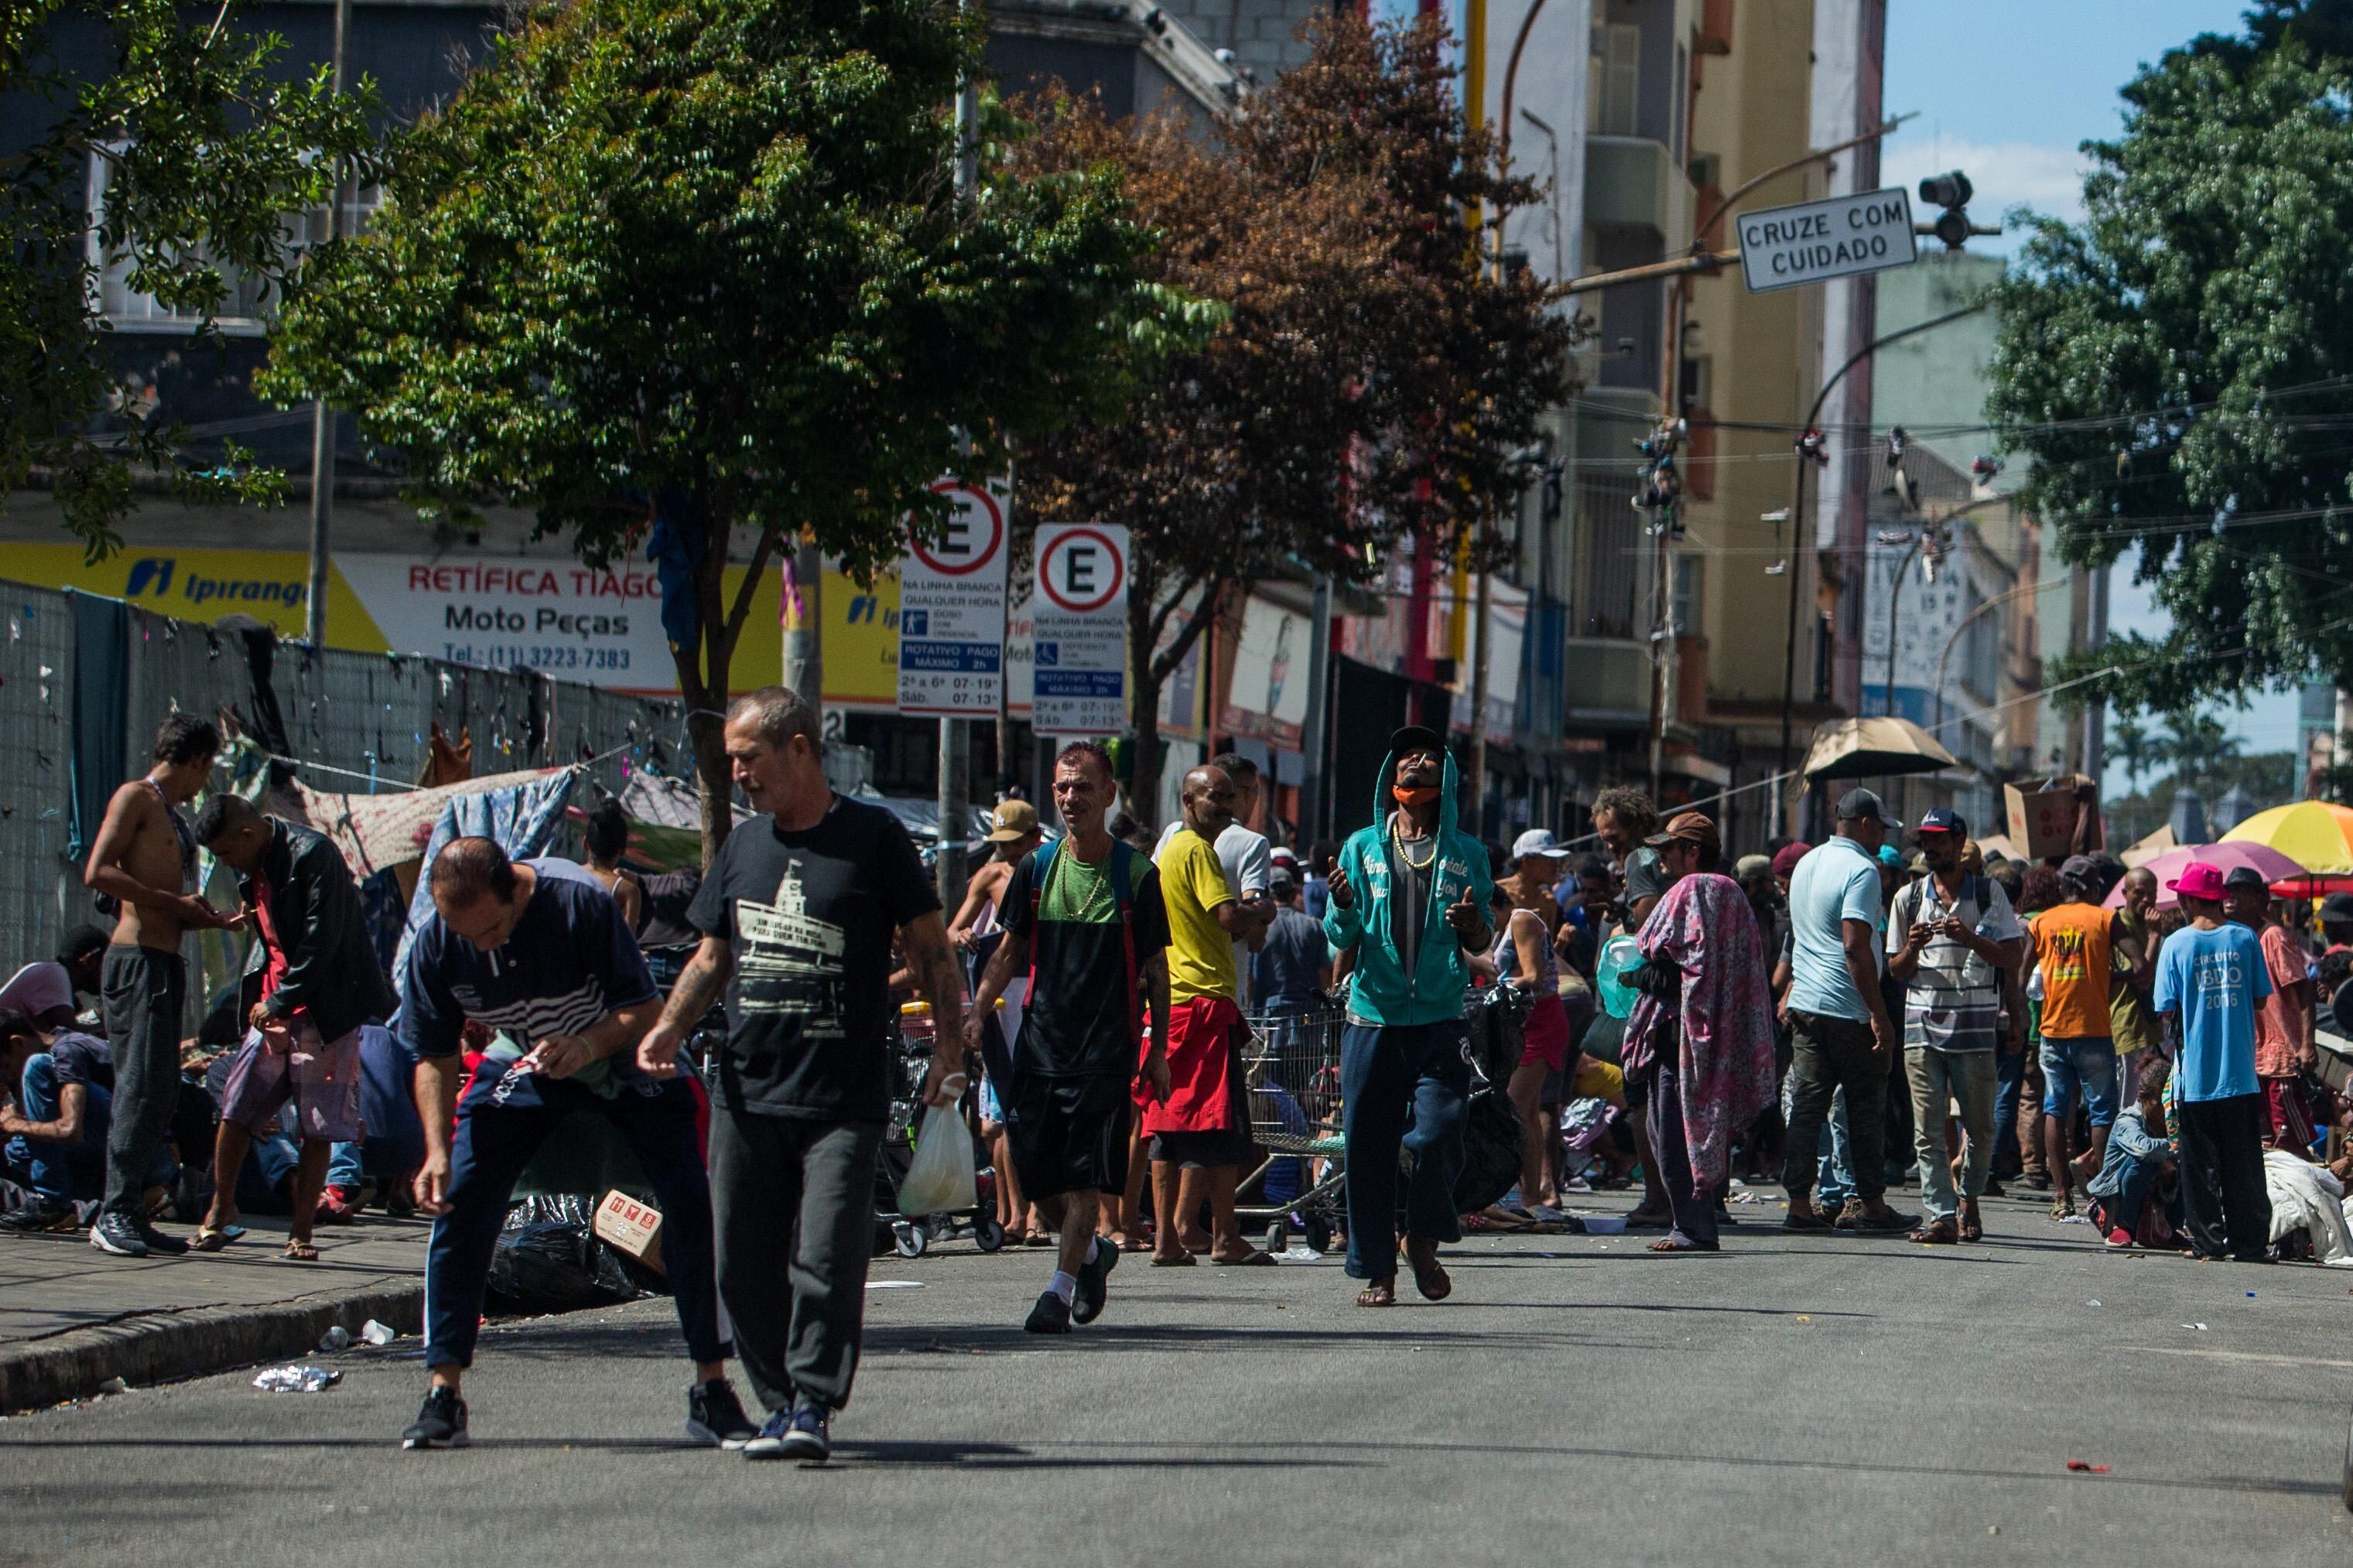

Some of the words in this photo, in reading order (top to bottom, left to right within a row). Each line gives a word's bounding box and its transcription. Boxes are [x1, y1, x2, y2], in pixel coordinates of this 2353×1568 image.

[1746, 214, 1831, 247] CRUZE
[1849, 201, 1903, 230] COM
[1772, 235, 1886, 273] CUIDADO
[939, 502, 972, 554] E
[409, 562, 560, 595] RETÍFICA
[569, 569, 663, 600] TIAGO
[1067, 547, 1096, 593] E
[903, 580, 918, 590] NA
[922, 581, 953, 591] LINHA
[956, 582, 1001, 593] BRANCA
[905, 594, 966, 606] QUALQUER
[969, 597, 1000, 607] HORA
[445, 605, 527, 633] Moto
[535, 608, 629, 639] Peças
[530, 647, 630, 669] 3223-7383
[905, 644, 959, 656] ROTATIVO
[967, 646, 998, 658] PAGO
[973, 659, 987, 670] 2h
[2206, 992, 2238, 1009] 2016
